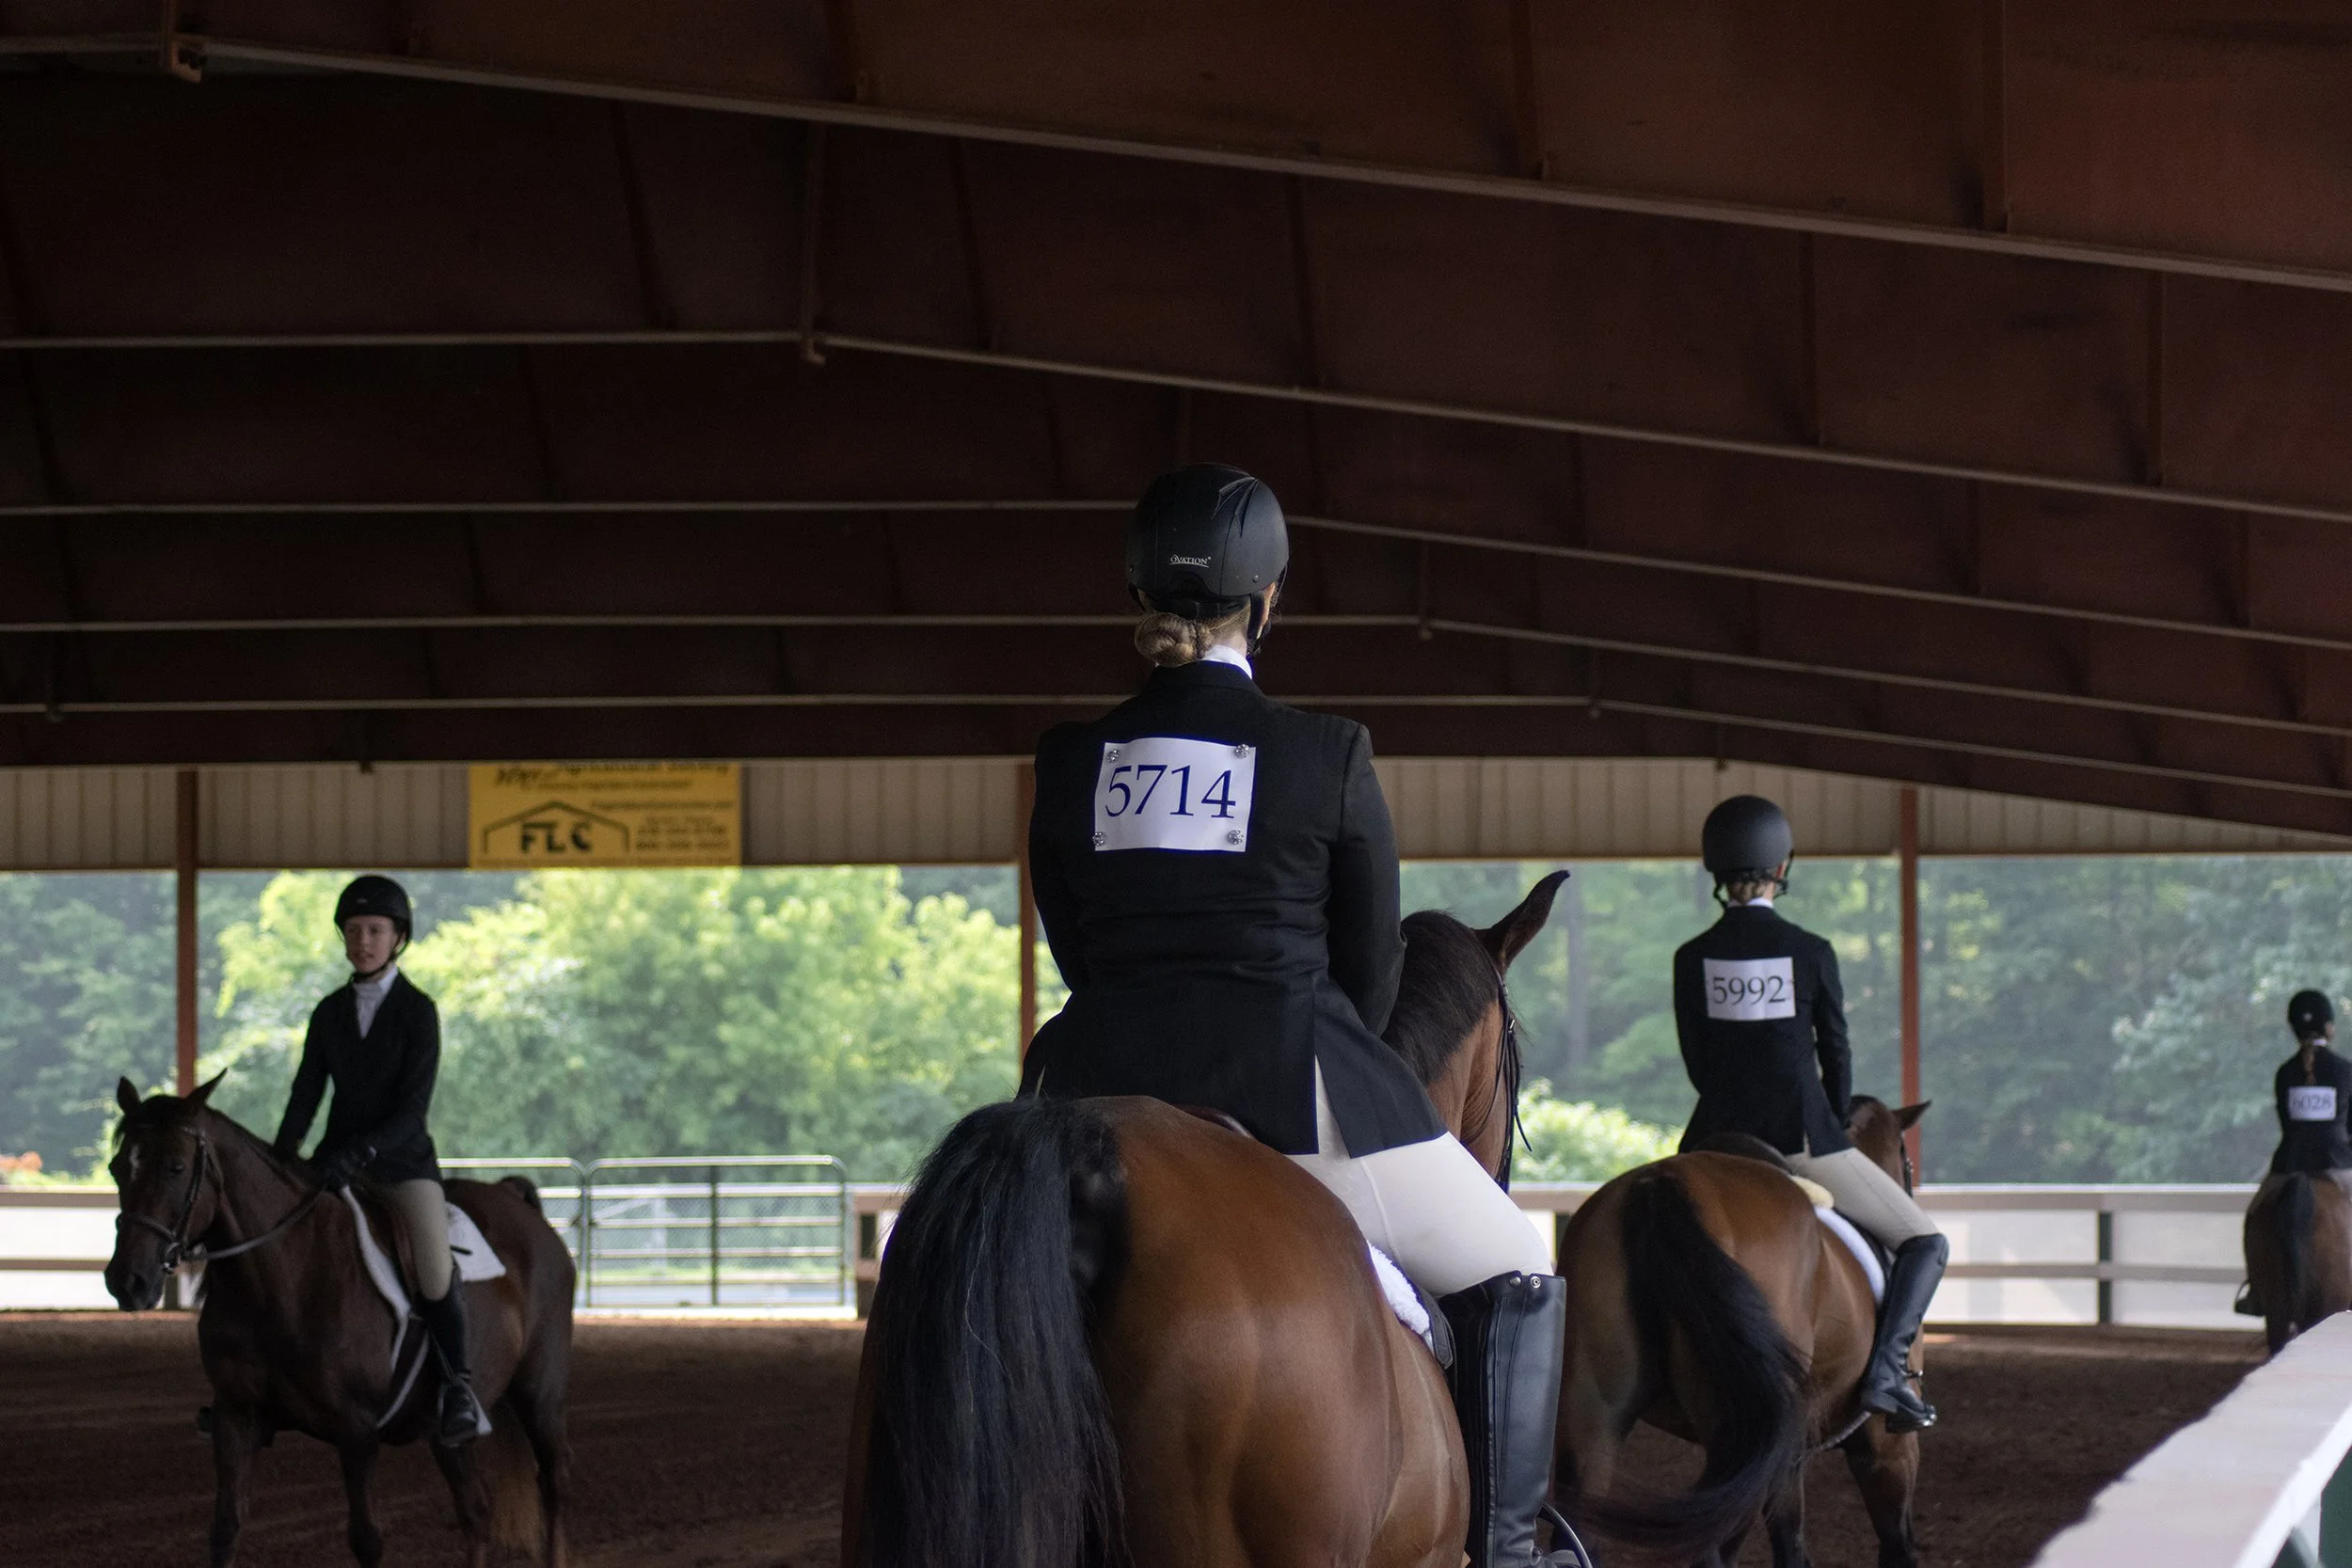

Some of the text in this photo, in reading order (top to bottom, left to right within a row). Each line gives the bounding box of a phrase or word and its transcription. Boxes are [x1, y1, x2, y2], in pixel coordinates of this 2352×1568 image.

[1169, 553, 1208, 565] OVATION
[1104, 764, 1236, 819] 5714
[521, 821, 593, 853] FLC
[1712, 975, 1786, 1006] 5992
